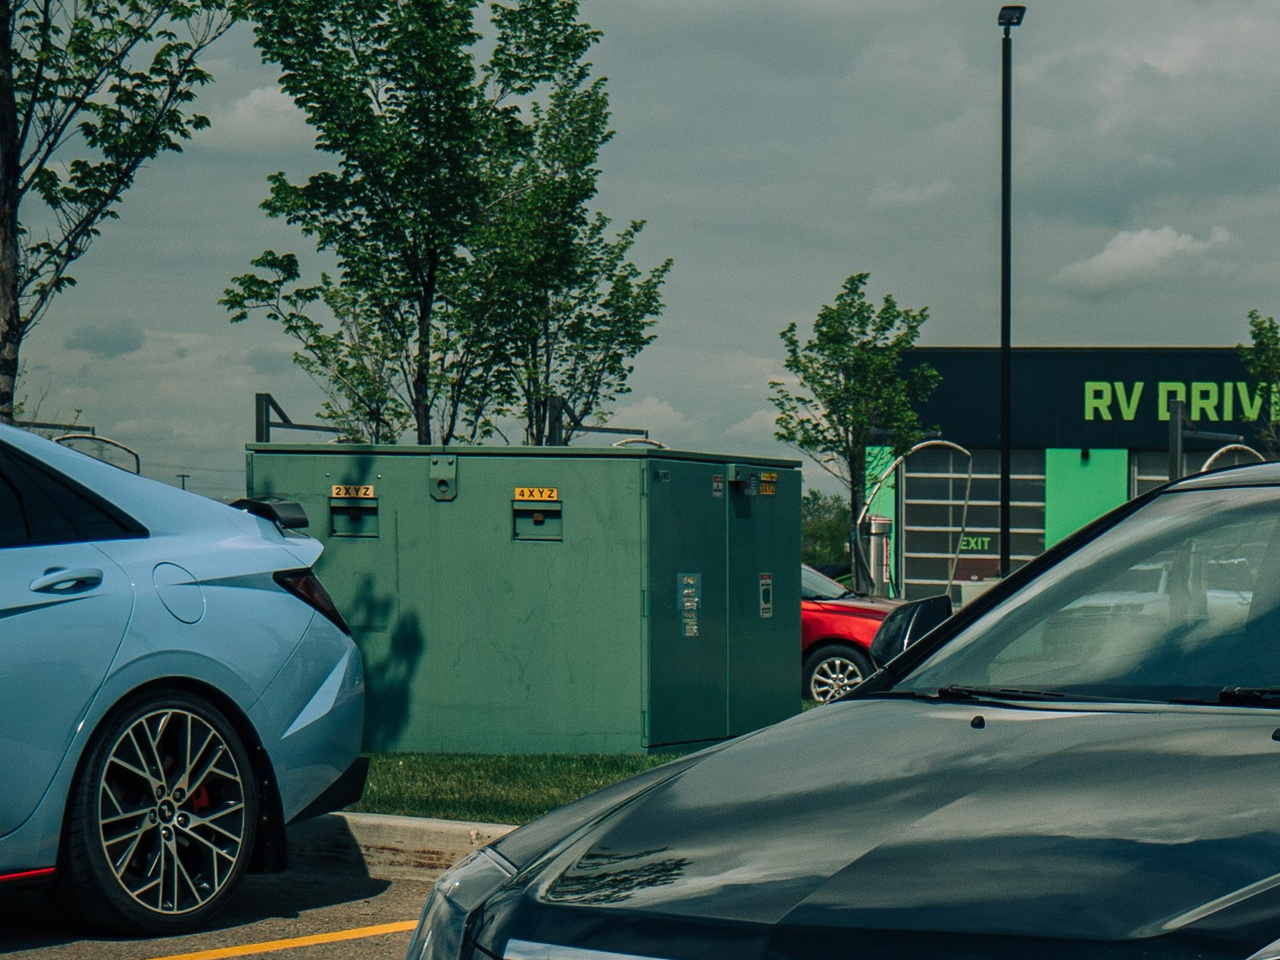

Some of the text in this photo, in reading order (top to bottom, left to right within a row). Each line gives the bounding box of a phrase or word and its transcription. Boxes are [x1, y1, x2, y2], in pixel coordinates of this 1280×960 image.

[1084, 381, 1145, 421] RV
[335, 486, 370, 497] 2XYZ
[518, 488, 555, 499] 4XYZ
[960, 536, 991, 550] EXIT
